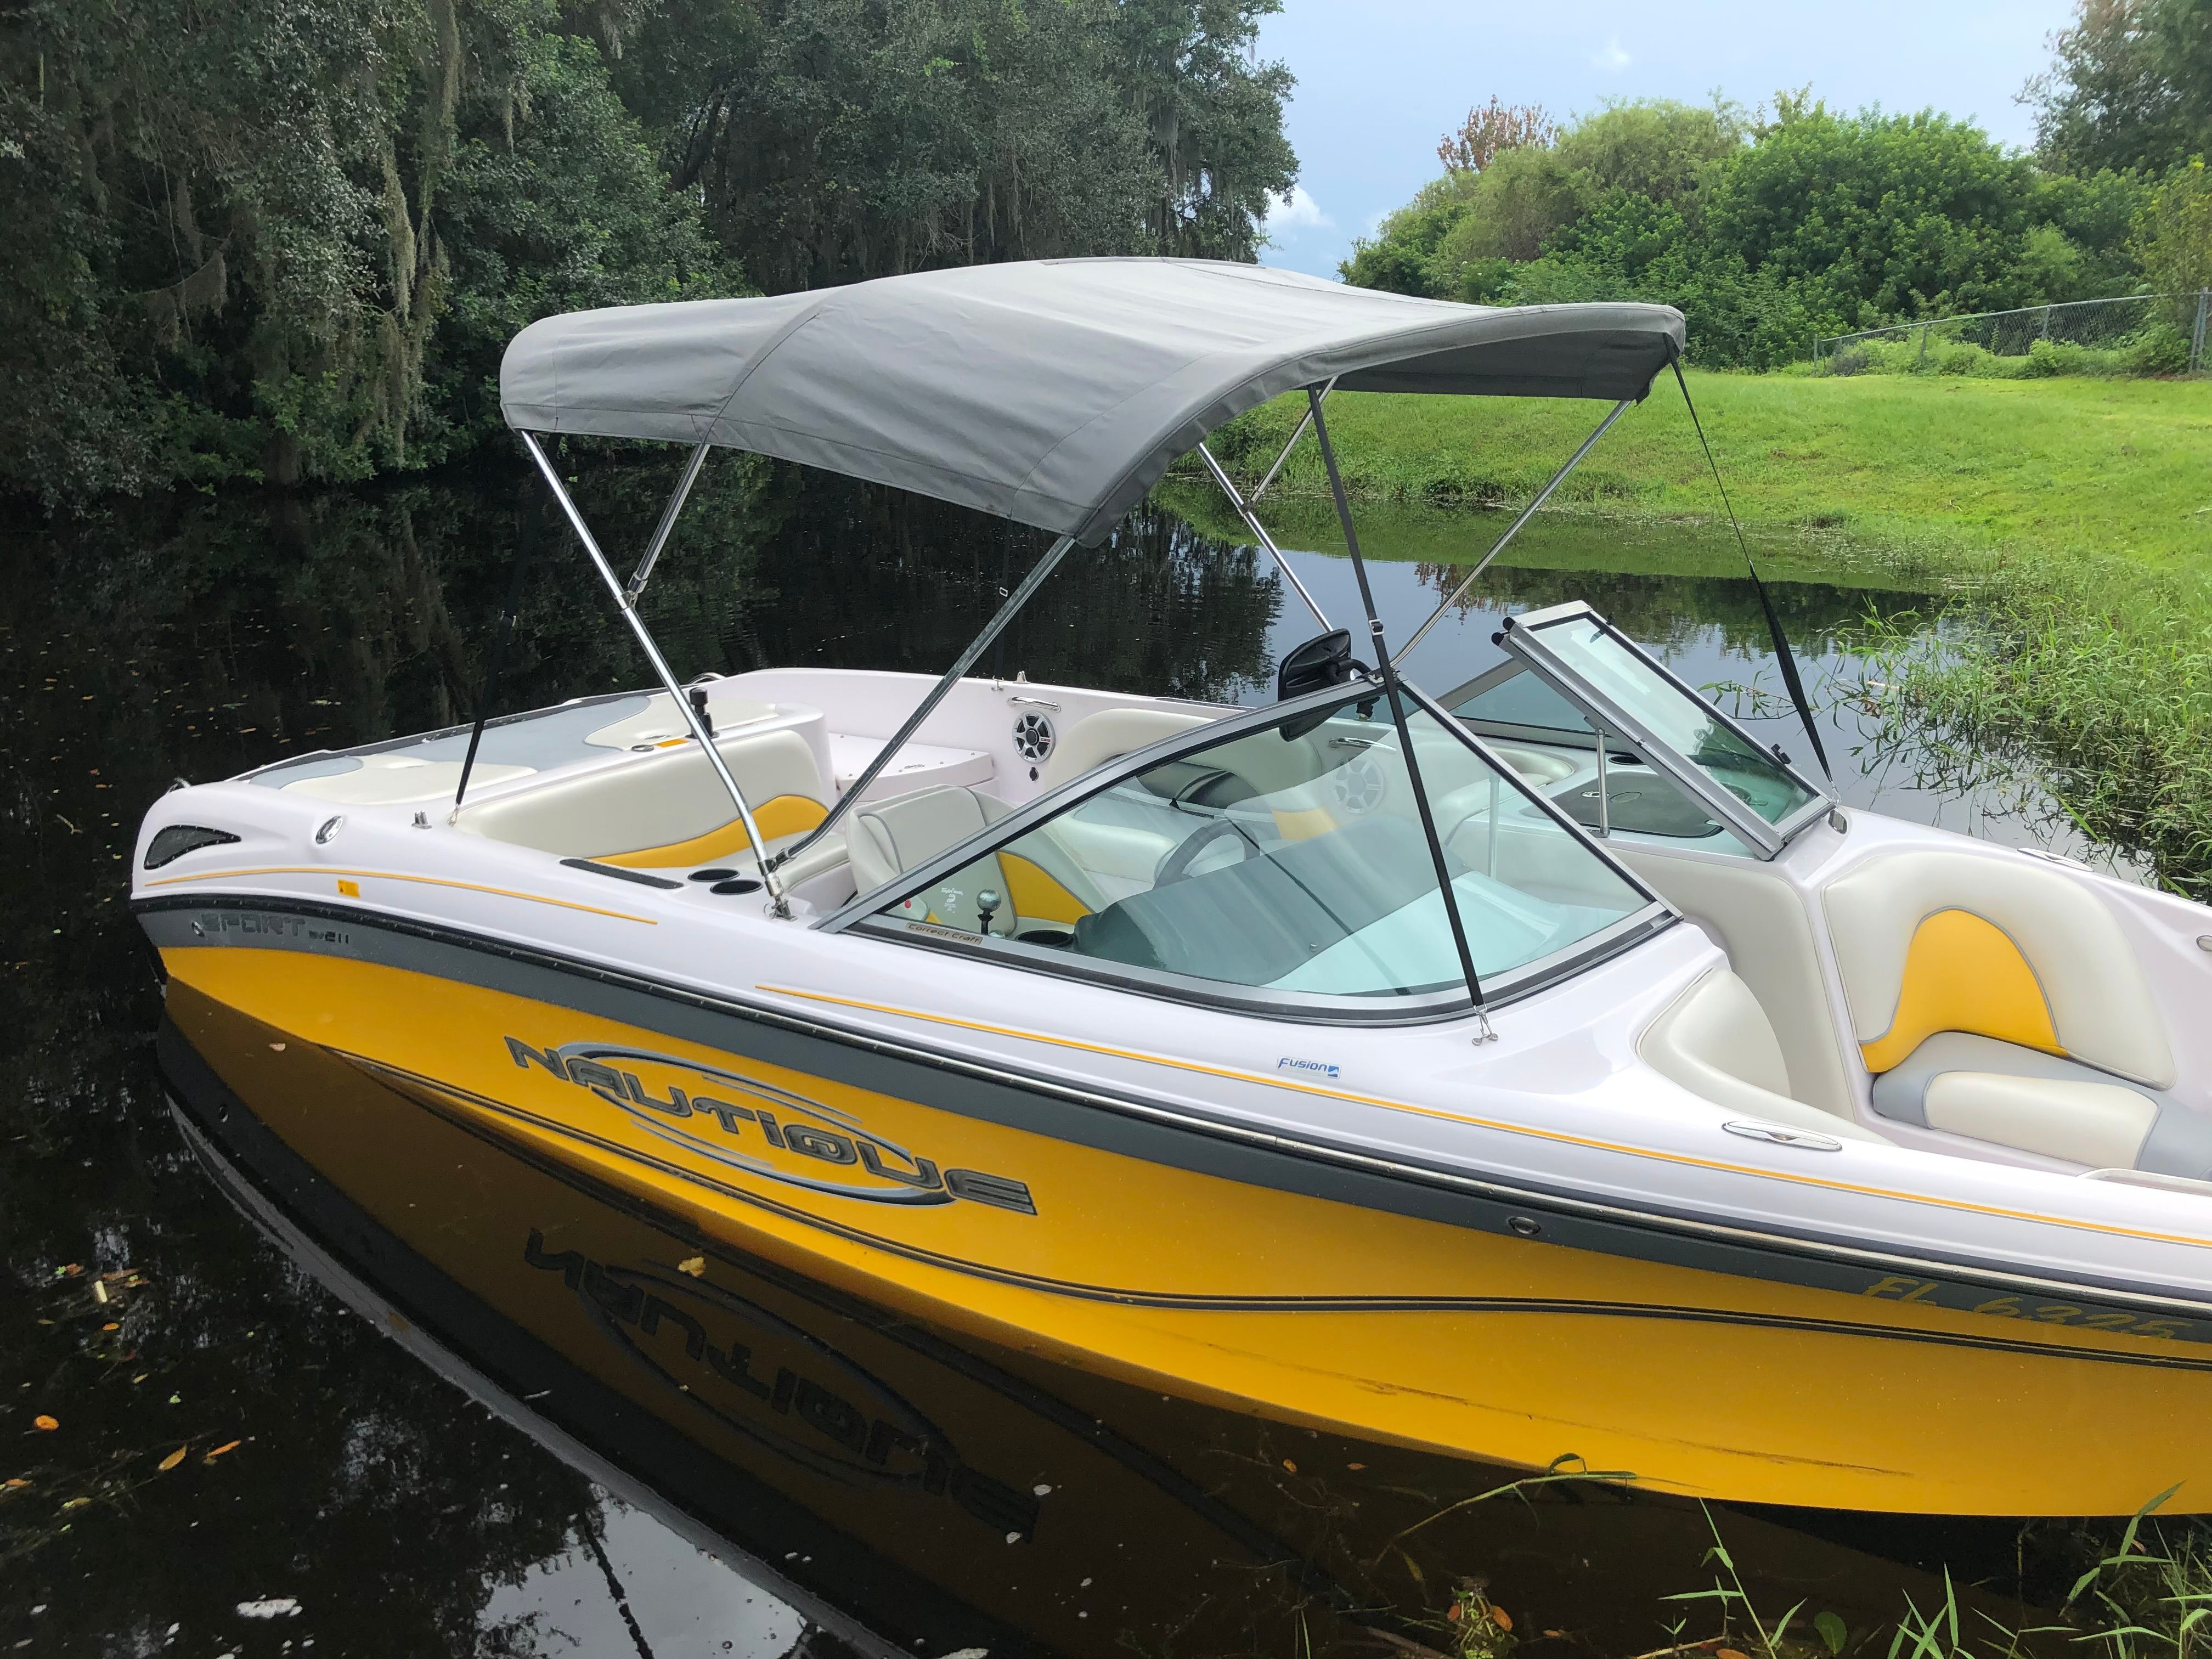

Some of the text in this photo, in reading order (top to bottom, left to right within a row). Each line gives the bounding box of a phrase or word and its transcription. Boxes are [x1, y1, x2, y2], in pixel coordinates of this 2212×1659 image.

[909, 923, 980, 943] Correct Craft
[1278, 1057, 1327, 1072] Fusion
[504, 1035, 1038, 1216] NAUTIQUE
[1863, 1276, 1939, 1306] FL
